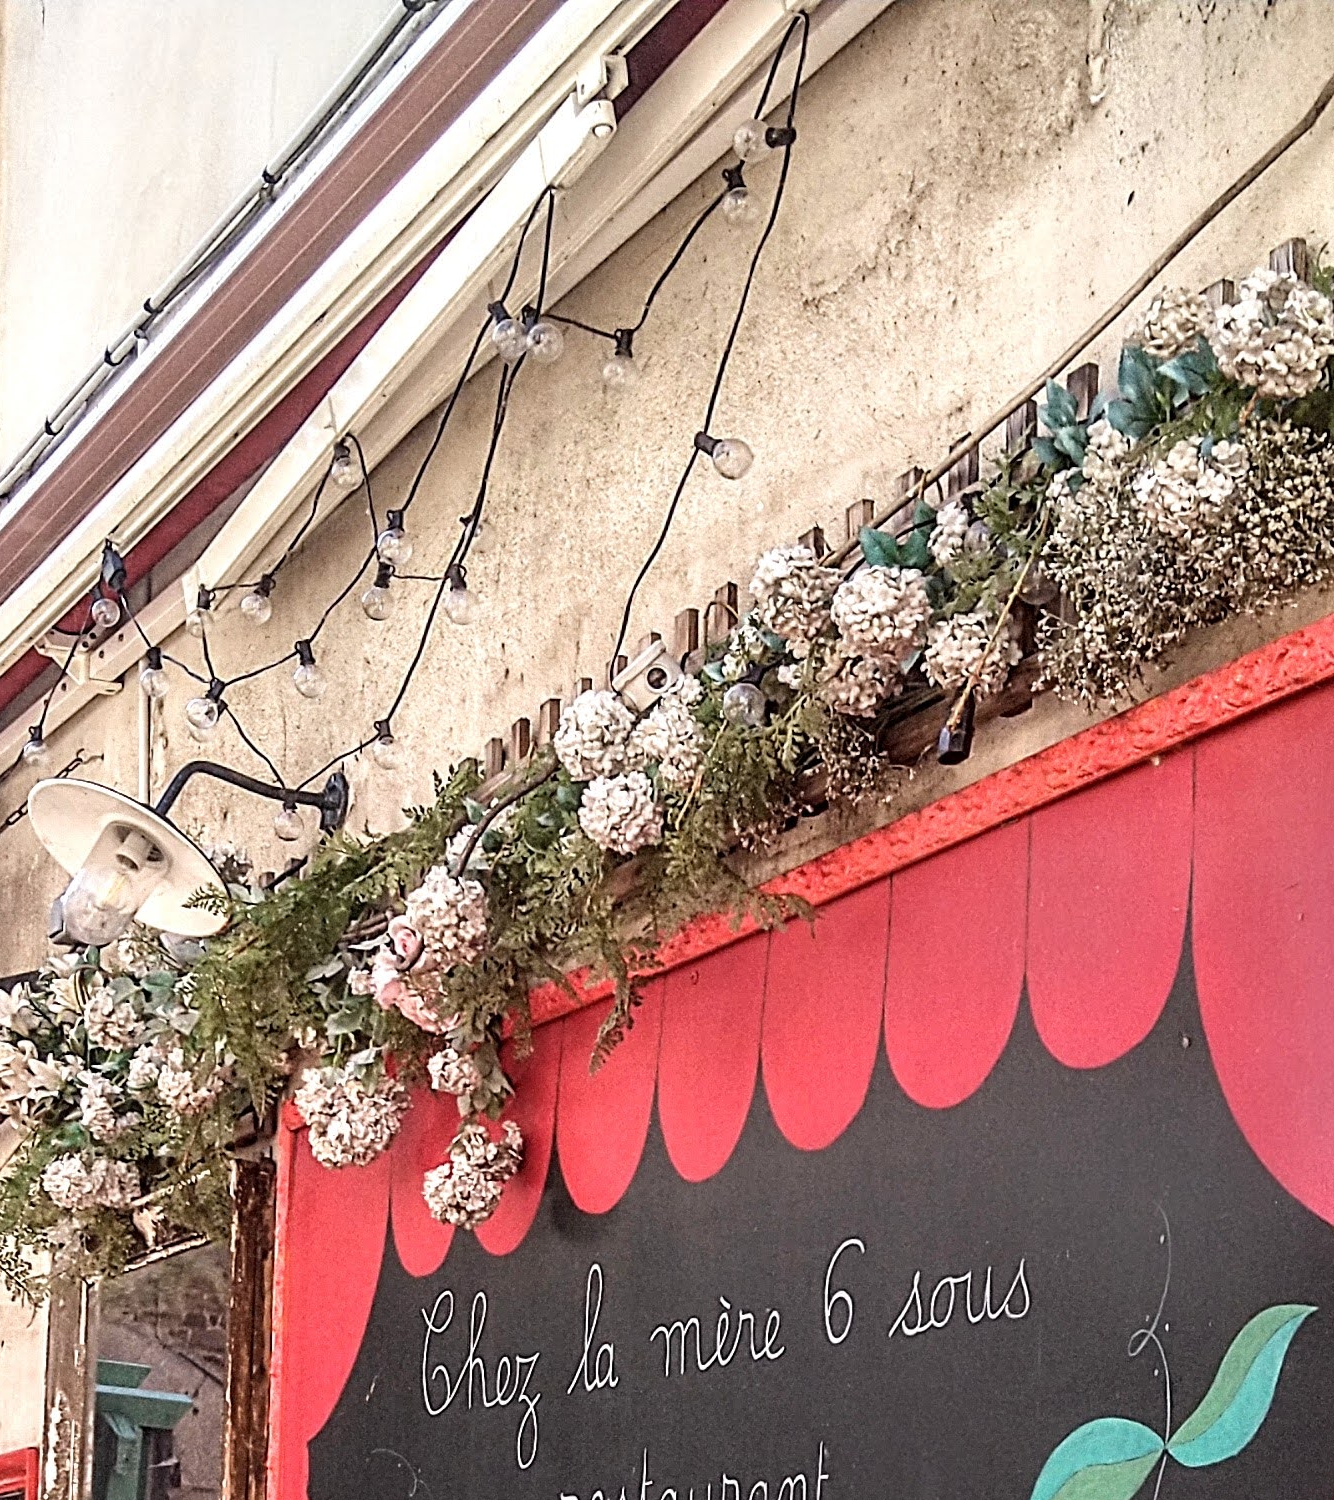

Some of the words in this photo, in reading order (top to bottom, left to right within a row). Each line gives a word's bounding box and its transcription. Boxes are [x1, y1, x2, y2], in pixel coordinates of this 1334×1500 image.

[421, 1290, 542, 1467] Chez
[567, 1263, 619, 1392] la
[650, 1296, 785, 1378] mère
[822, 1238, 865, 1343] 6
[888, 1257, 1031, 1337] sous
